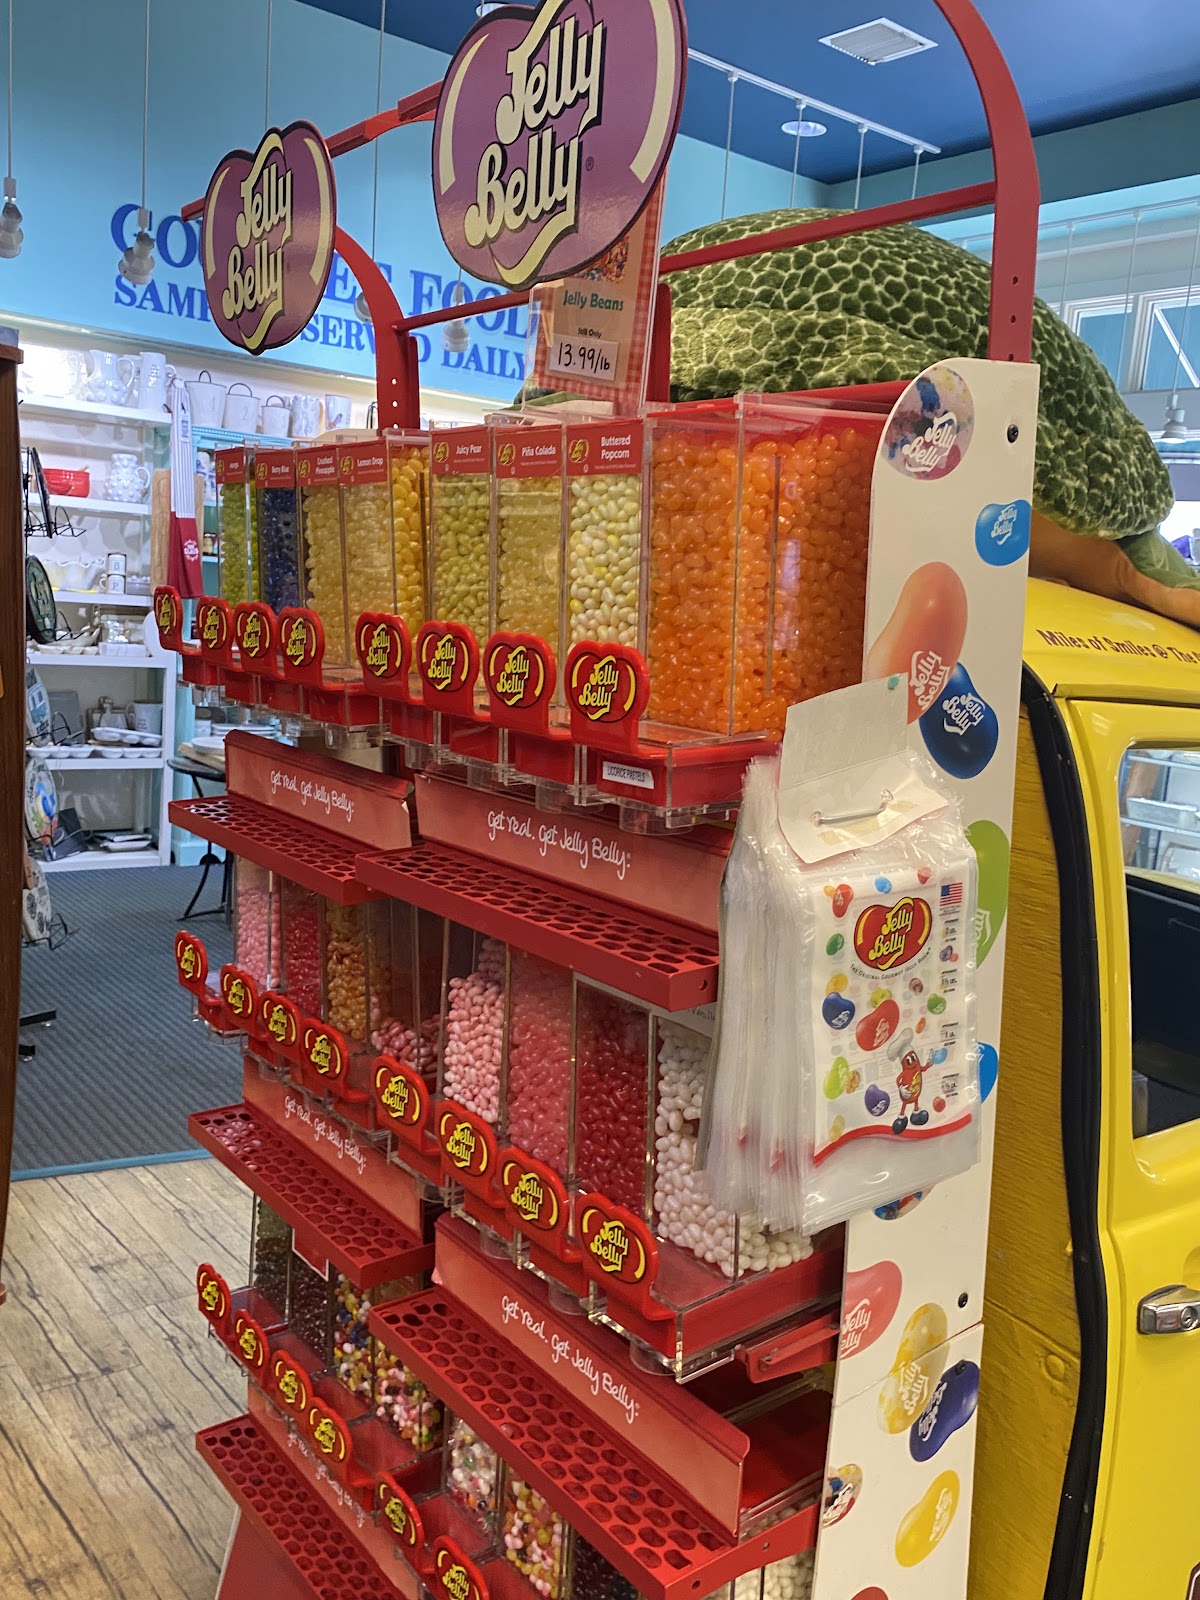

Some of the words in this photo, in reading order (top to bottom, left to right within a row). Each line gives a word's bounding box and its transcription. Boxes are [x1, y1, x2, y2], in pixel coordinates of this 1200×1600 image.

[495, 4, 606, 145] Jelly
[236, 158, 293, 248] Jelly
[464, 126, 582, 252] Belly
[222, 240, 285, 326] Belly
[563, 290, 588, 310] Jelly
[589, 293, 624, 311] Beans
[558, 342, 611, 374] 13.99/lb
[601, 435, 631, 447] Buttered
[925, 412, 957, 456] Jelly
[455, 445, 470, 456] Juicy
[470, 444, 482, 454] Pear
[521, 446, 535, 457] Piña
[535, 445, 557, 456] Colada
[601, 449, 630, 461] Popcorn
[902, 436, 941, 470] Belly
[372, 626, 390, 652] Jelly
[435, 637, 457, 663] Jelly
[1036, 629, 1090, 649] Miles
[1088, 635, 1108, 651] of
[1103, 636, 1157, 658] Smiles
[1166, 647, 1198, 664] The
[366, 645, 388, 668] Belly
[428, 658, 452, 680] Belly
[505, 650, 530, 678] Jelly
[497, 671, 524, 697] Belly
[590, 660, 619, 691] Jelly
[910, 651, 942, 696] Jelly
[918, 665, 950, 710] Belly
[579, 683, 612, 710] Belly
[960, 693, 985, 726] Jelly
[942, 696, 971, 733] Belly
[506, 816, 535, 840] real.
[559, 828, 588, 869] Jelly
[881, 902, 913, 935] Jelly
[868, 932, 905, 962] Belly
[446, 1136, 470, 1164] Belly
[454, 1124, 475, 1152] Jelly
[511, 1186, 539, 1217] Belly
[519, 1174, 543, 1204] Jelly
[590, 1235, 622, 1268] Belly
[600, 1223, 628, 1255] Jelly
[519, 1308, 549, 1343] real.
[571, 1348, 599, 1395] Jelly
